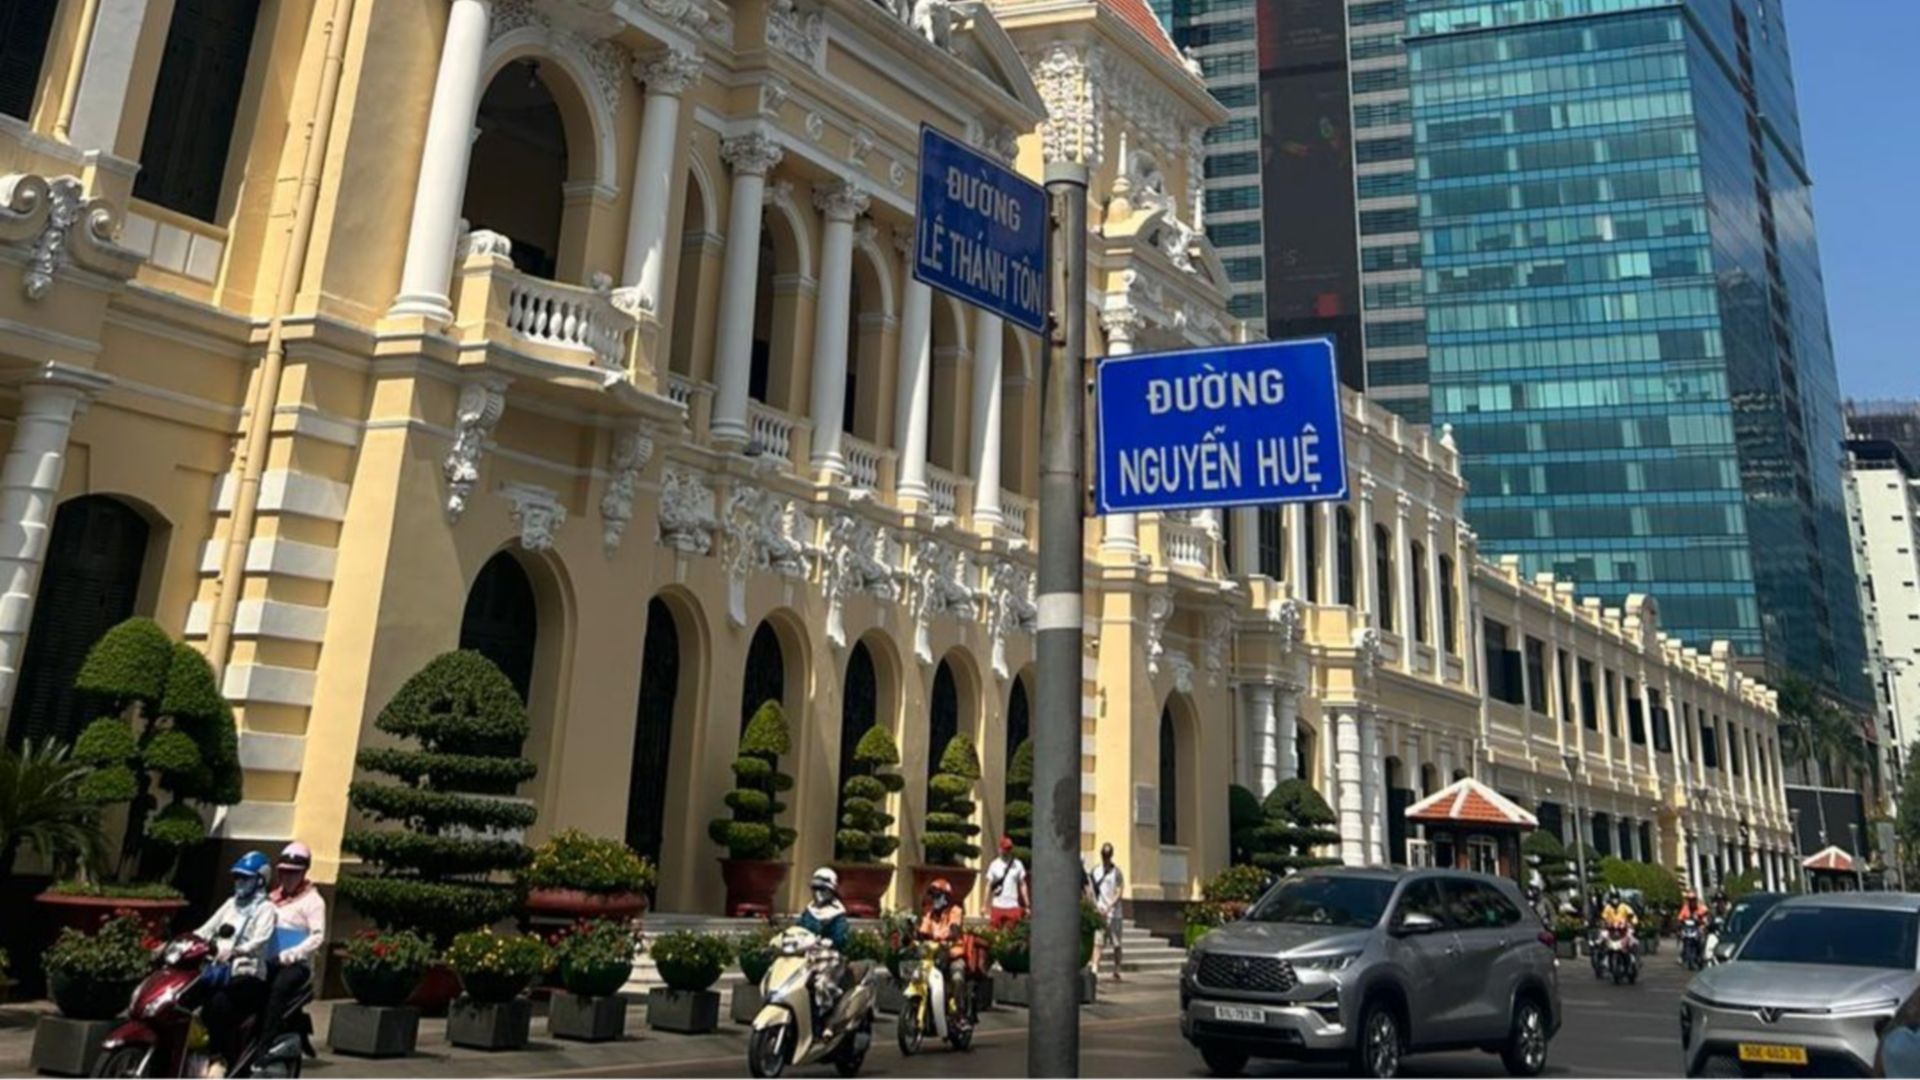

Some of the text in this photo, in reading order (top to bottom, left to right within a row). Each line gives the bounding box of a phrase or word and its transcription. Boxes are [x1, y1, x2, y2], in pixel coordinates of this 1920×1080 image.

[946, 165, 1021, 232] ĐƯỜNG
[920, 213, 1043, 316] LÊ THÁNH TÔN
[1146, 363, 1285, 415] ĐƯỜNG
[1119, 422, 1322, 496] NGUYỄN HUỆ
